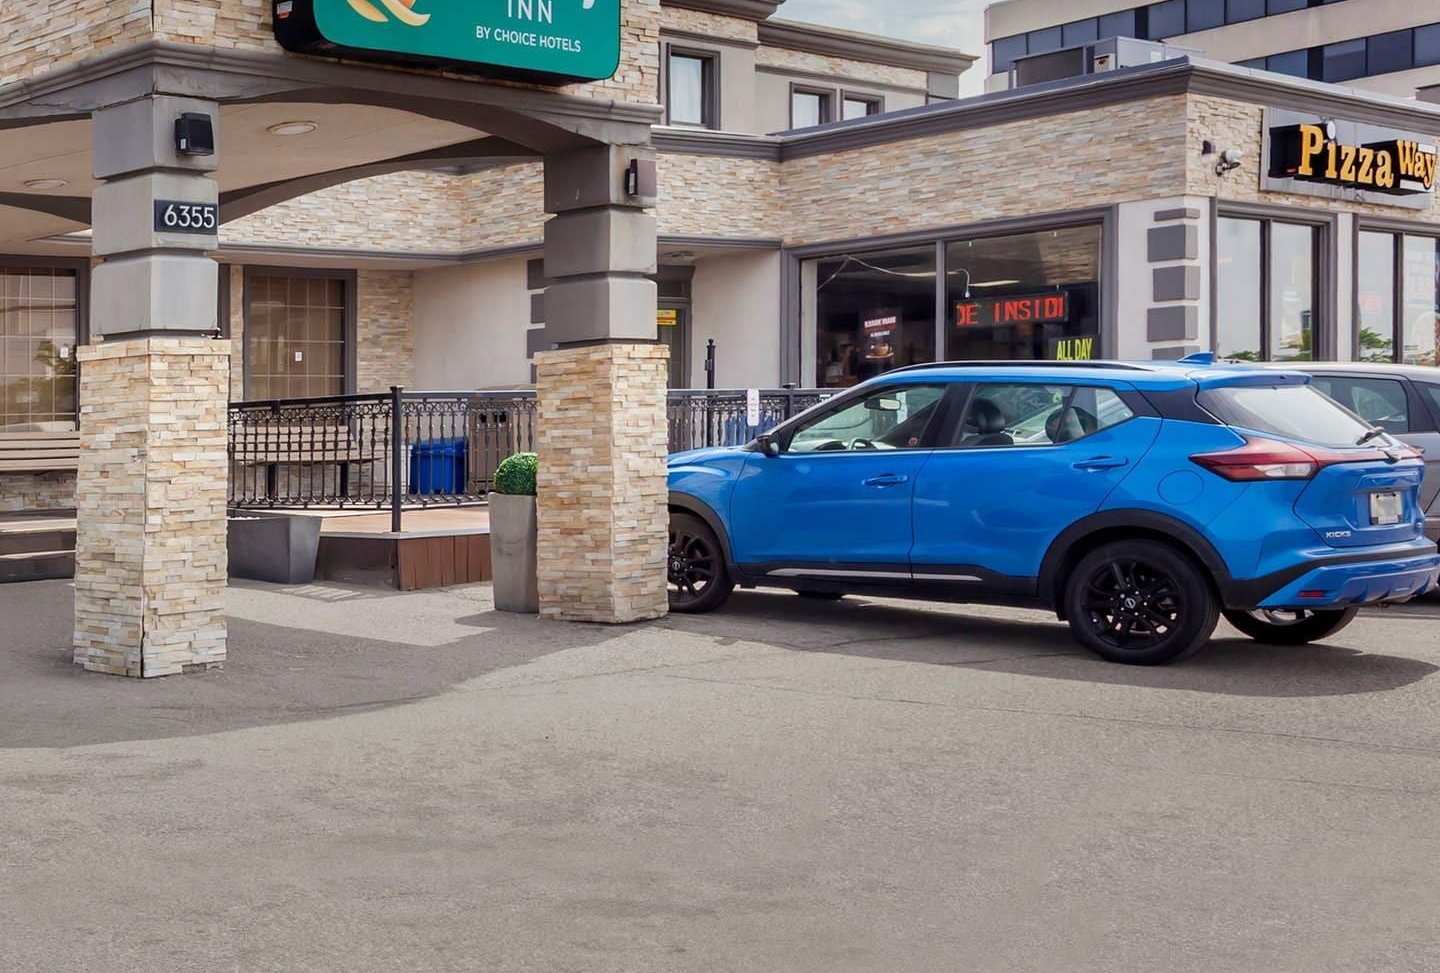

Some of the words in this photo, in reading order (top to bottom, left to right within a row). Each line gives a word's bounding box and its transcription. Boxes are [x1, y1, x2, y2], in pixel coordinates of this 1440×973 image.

[476, 26, 492, 40] BY
[494, 28, 537, 47] CHOICE
[539, 34, 582, 53] HOTELS
[1298, 124, 1394, 189] Pizza
[1396, 139, 1437, 189] Way
[164, 204, 215, 228] 6355
[1056, 340, 1074, 362] ALL
[1074, 338, 1093, 361] DAY
